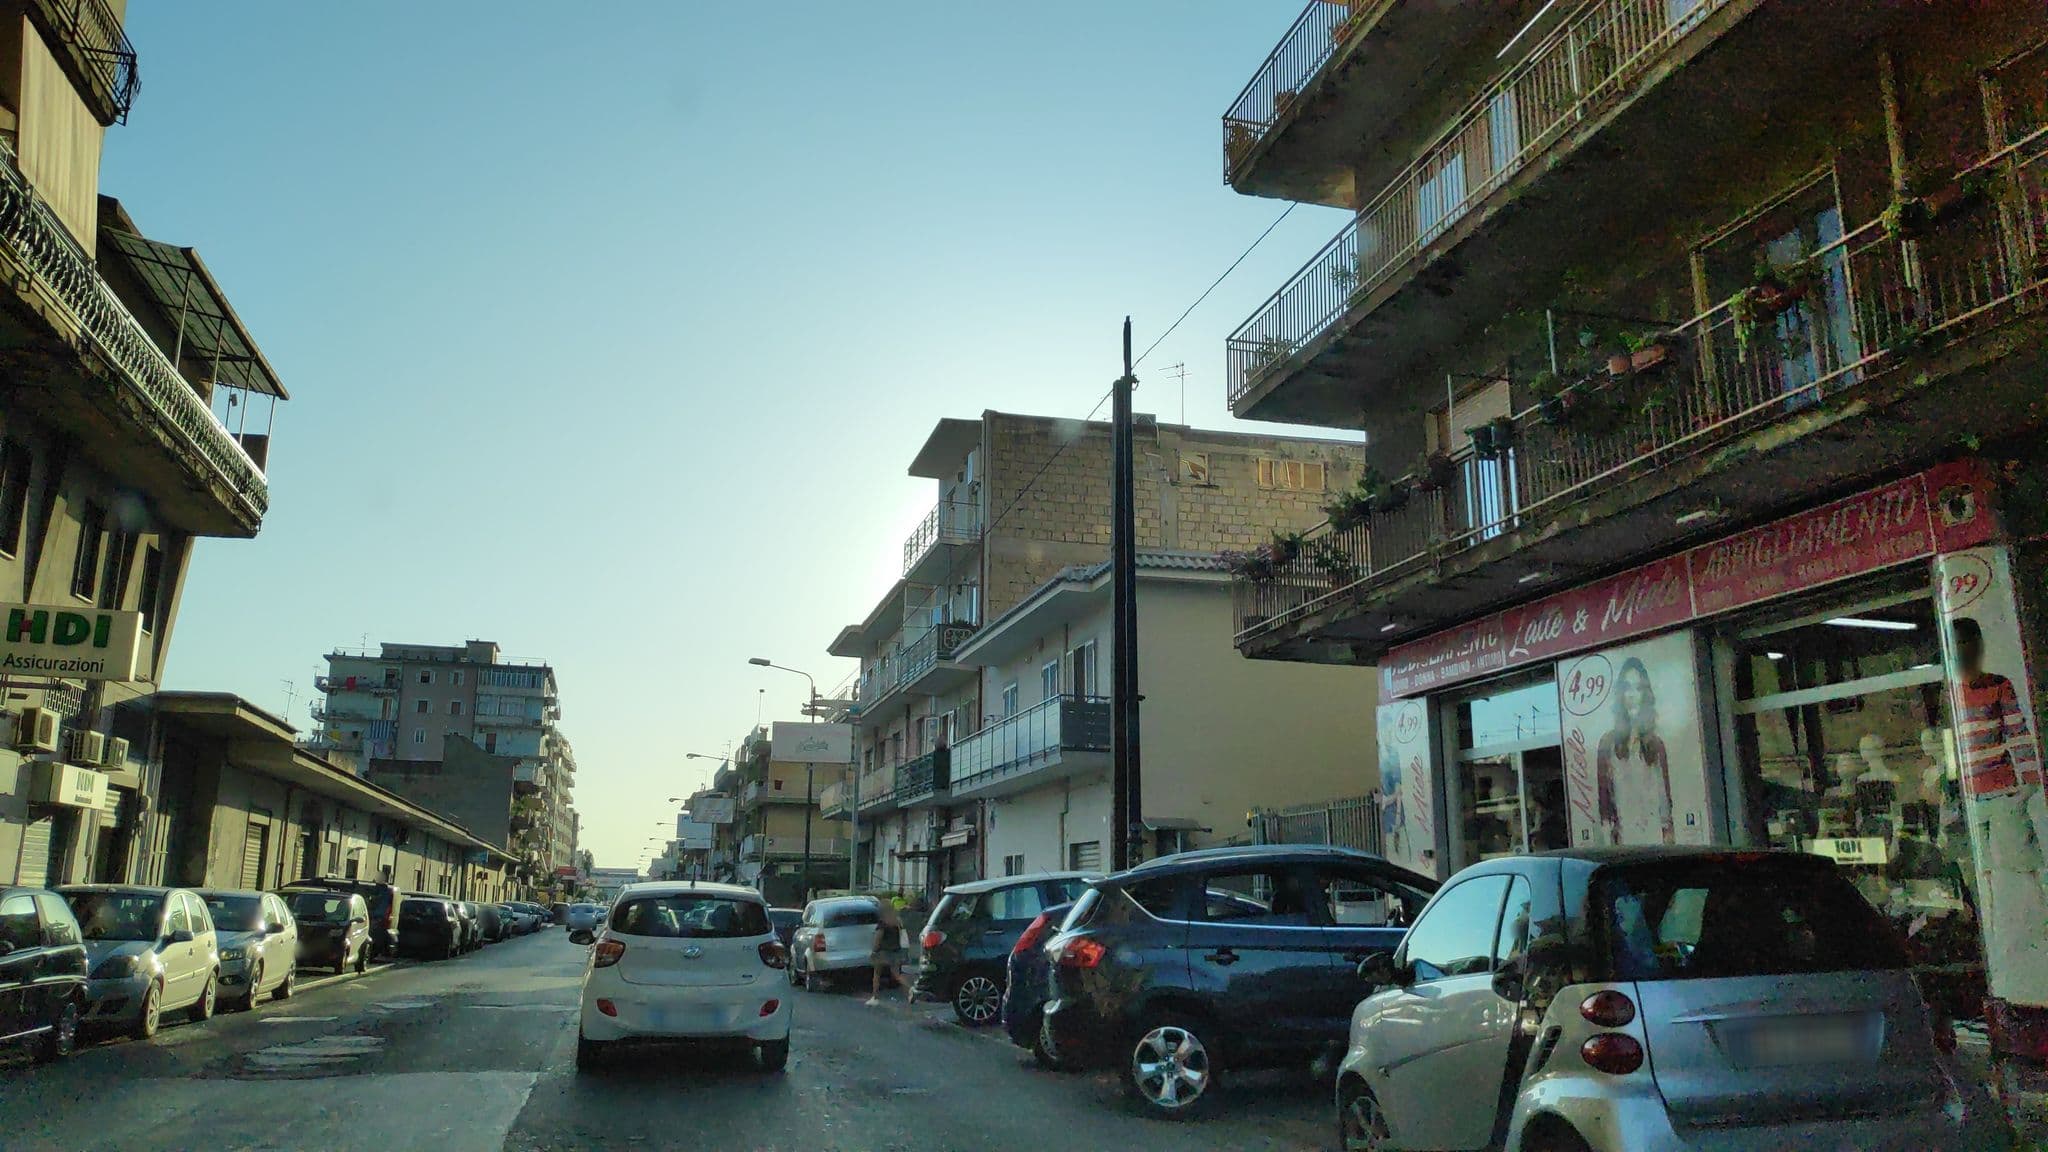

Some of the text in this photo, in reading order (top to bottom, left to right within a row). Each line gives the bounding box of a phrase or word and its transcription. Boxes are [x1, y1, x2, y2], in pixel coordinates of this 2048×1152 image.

[6, 608, 112, 648] HDI
[1573, 608, 1589, 635] &
[2, 653, 105, 673] Assicurazioni
[1569, 670, 1604, 704] 4,99
[1399, 712, 1418, 735] 4,99
[1566, 727, 1596, 824] Miele
